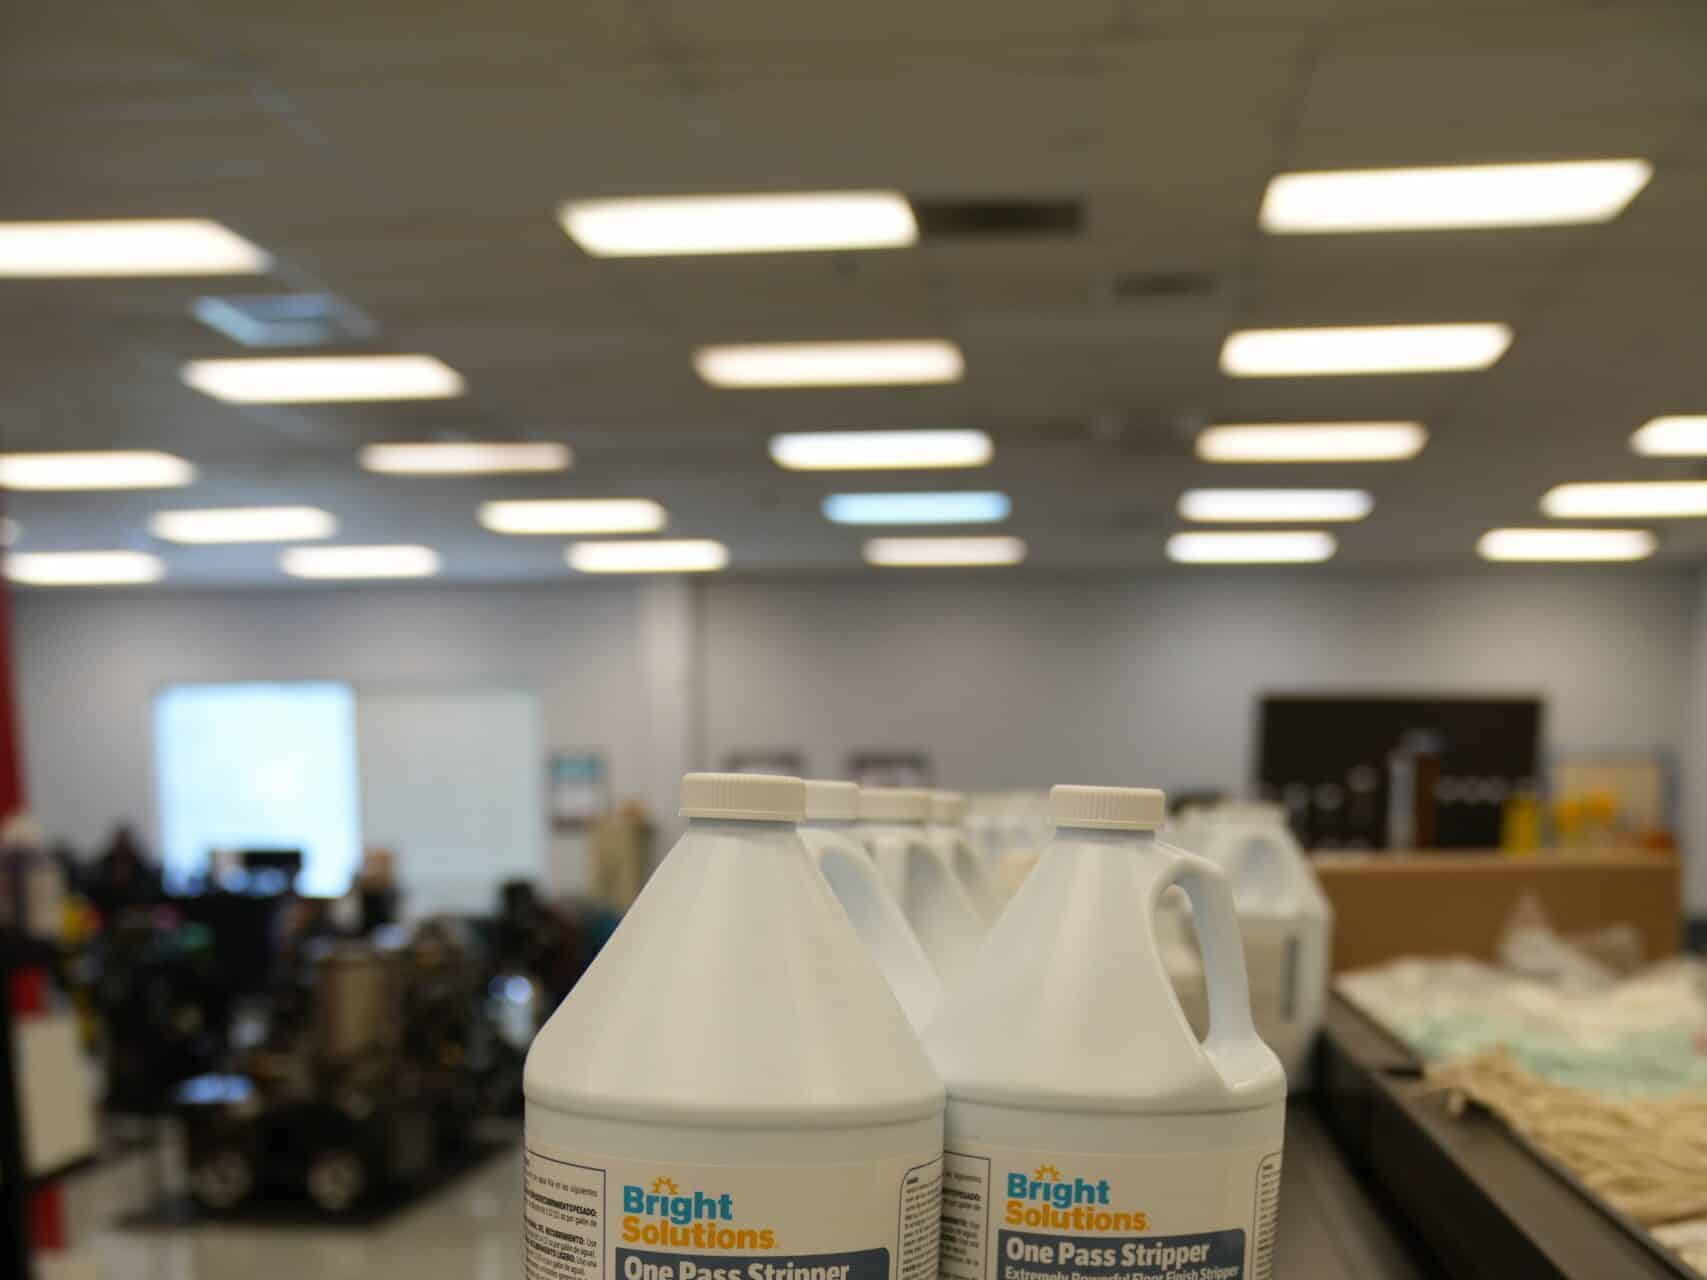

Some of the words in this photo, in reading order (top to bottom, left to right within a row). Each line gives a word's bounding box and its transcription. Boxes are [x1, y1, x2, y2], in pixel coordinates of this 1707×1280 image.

[624, 1185, 733, 1224] Bright
[1007, 1172, 1110, 1208] Bright
[622, 1215, 774, 1249] Solutions
[1005, 1200, 1147, 1232] Solutions
[1006, 1237, 1054, 1264] One
[1058, 1242, 1116, 1266] Pass
[1121, 1242, 1210, 1271] Stripper
